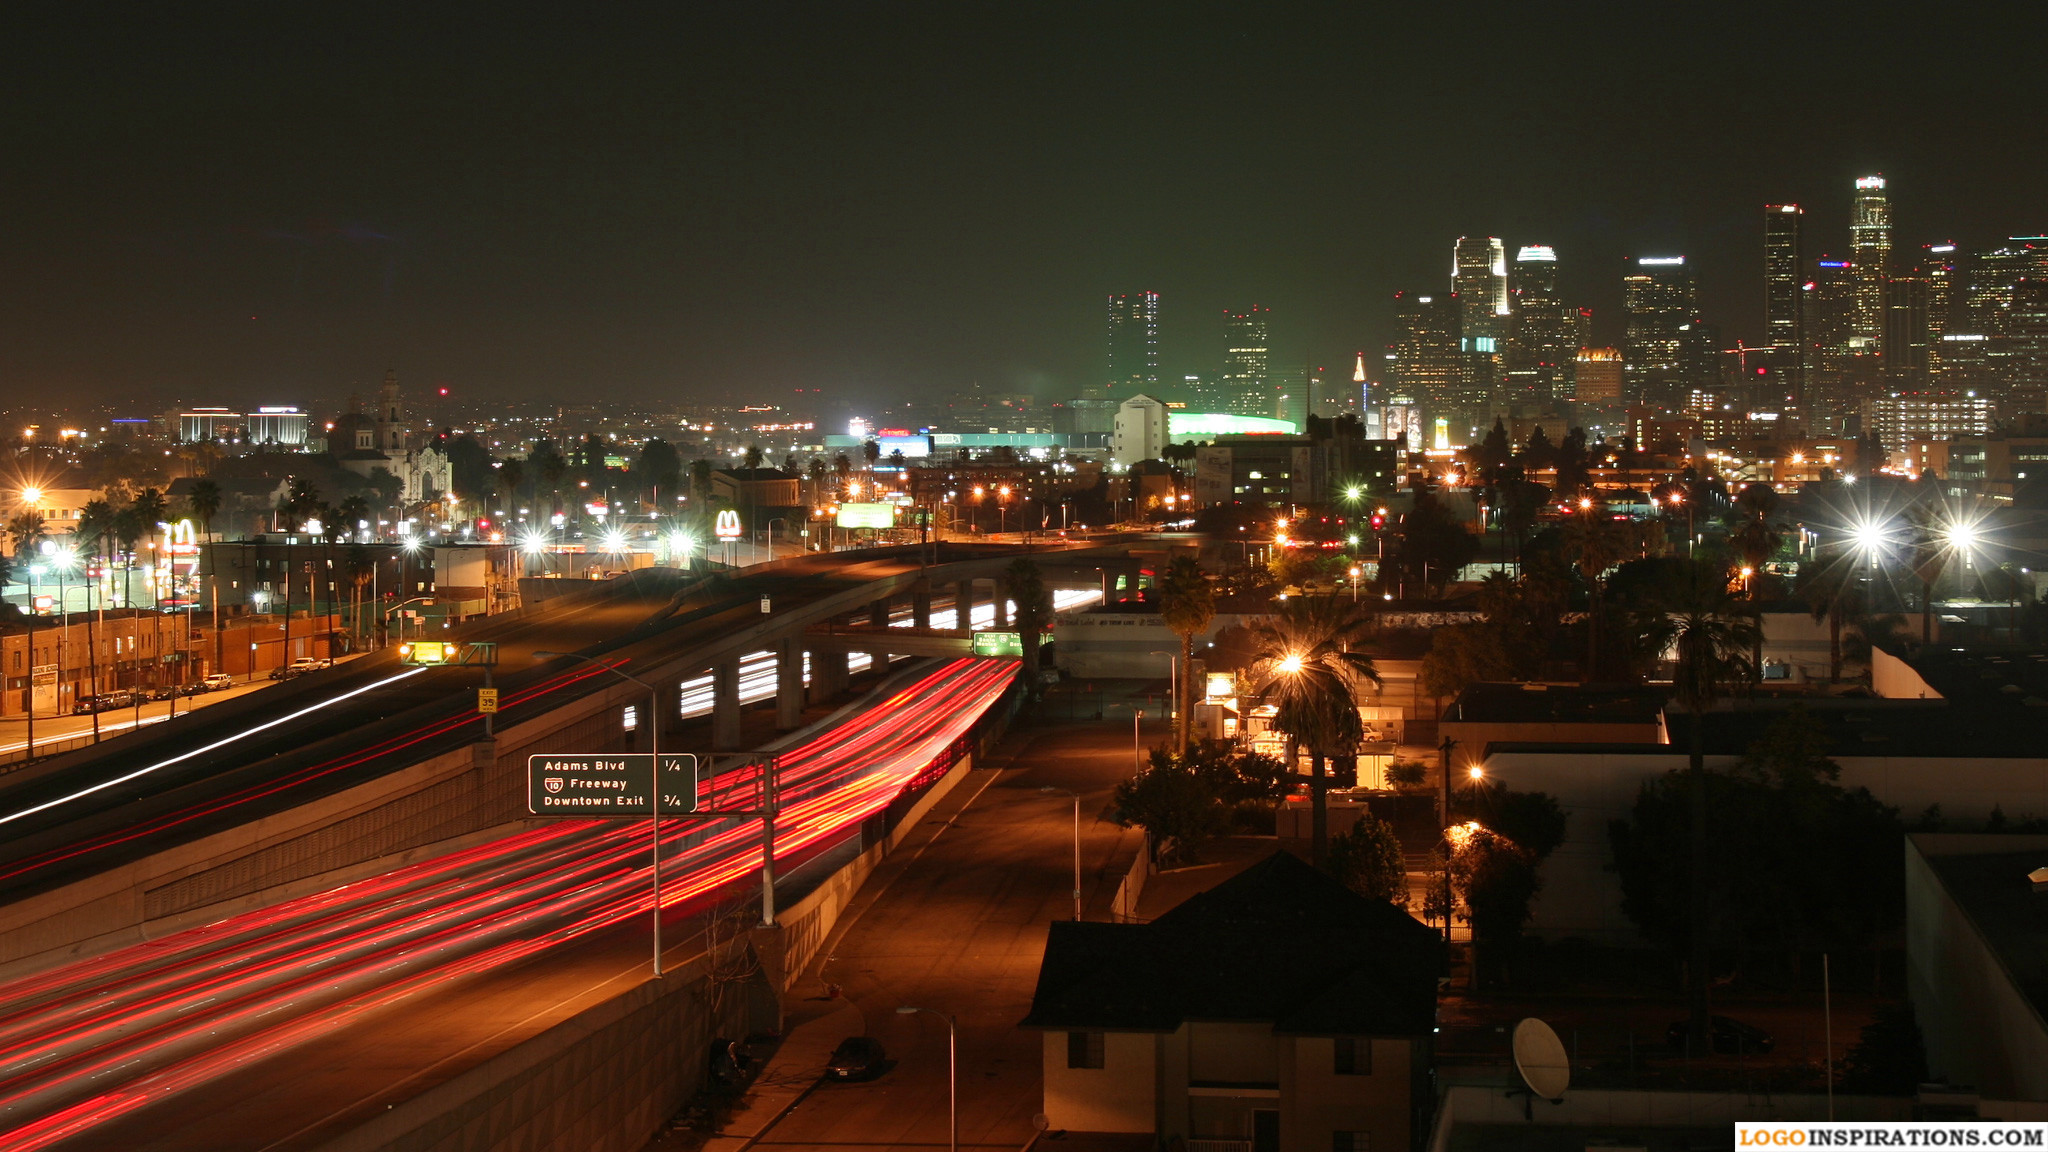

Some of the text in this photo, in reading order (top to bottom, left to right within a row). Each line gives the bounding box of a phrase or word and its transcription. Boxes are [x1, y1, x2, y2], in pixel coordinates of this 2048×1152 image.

[544, 760, 681, 772] Adams Blvd 1/4
[549, 778, 627, 791] 10 Freeway
[544, 795, 681, 807] Downtown Exit 3/4
